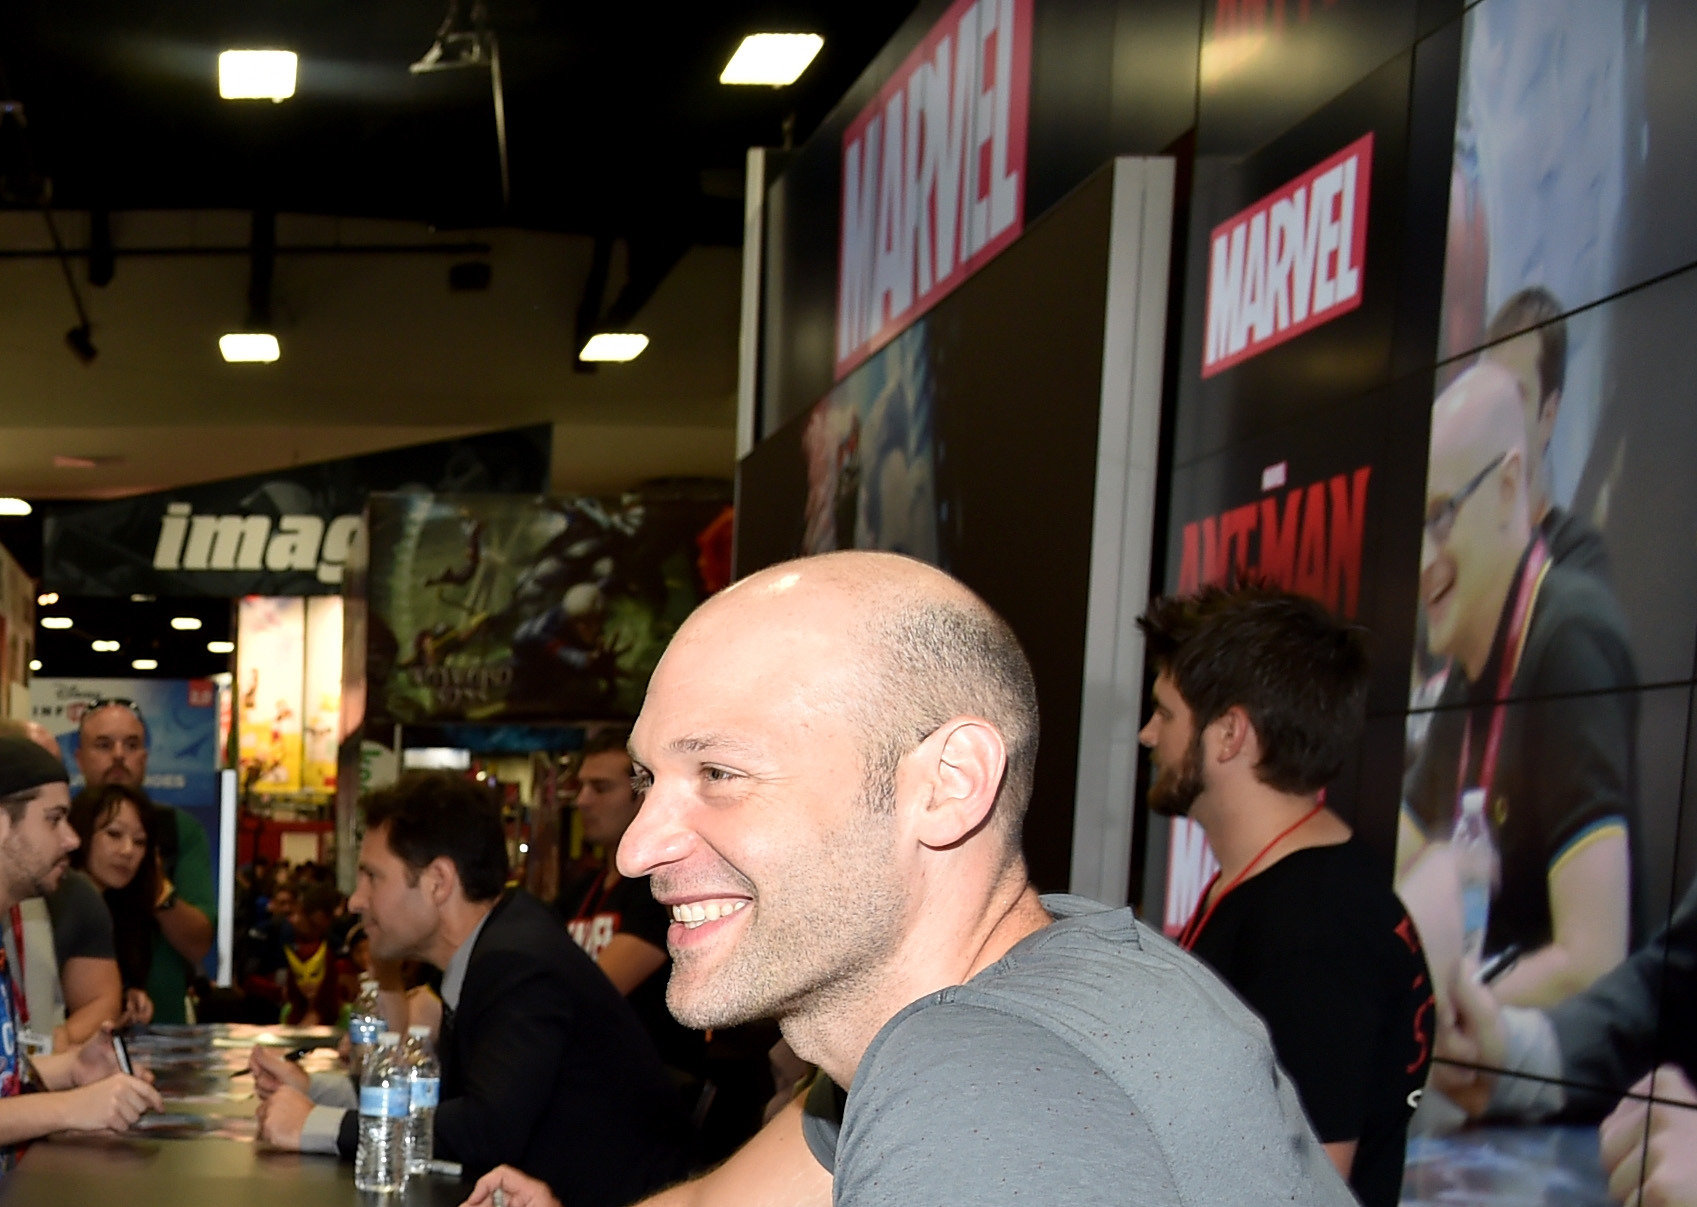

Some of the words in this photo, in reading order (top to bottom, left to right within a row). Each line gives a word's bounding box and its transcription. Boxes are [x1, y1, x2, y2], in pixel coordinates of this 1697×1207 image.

[837, 0, 1019, 363] MARVEL
[1206, 155, 1359, 365] MARVEL
[152, 502, 367, 583] imag
